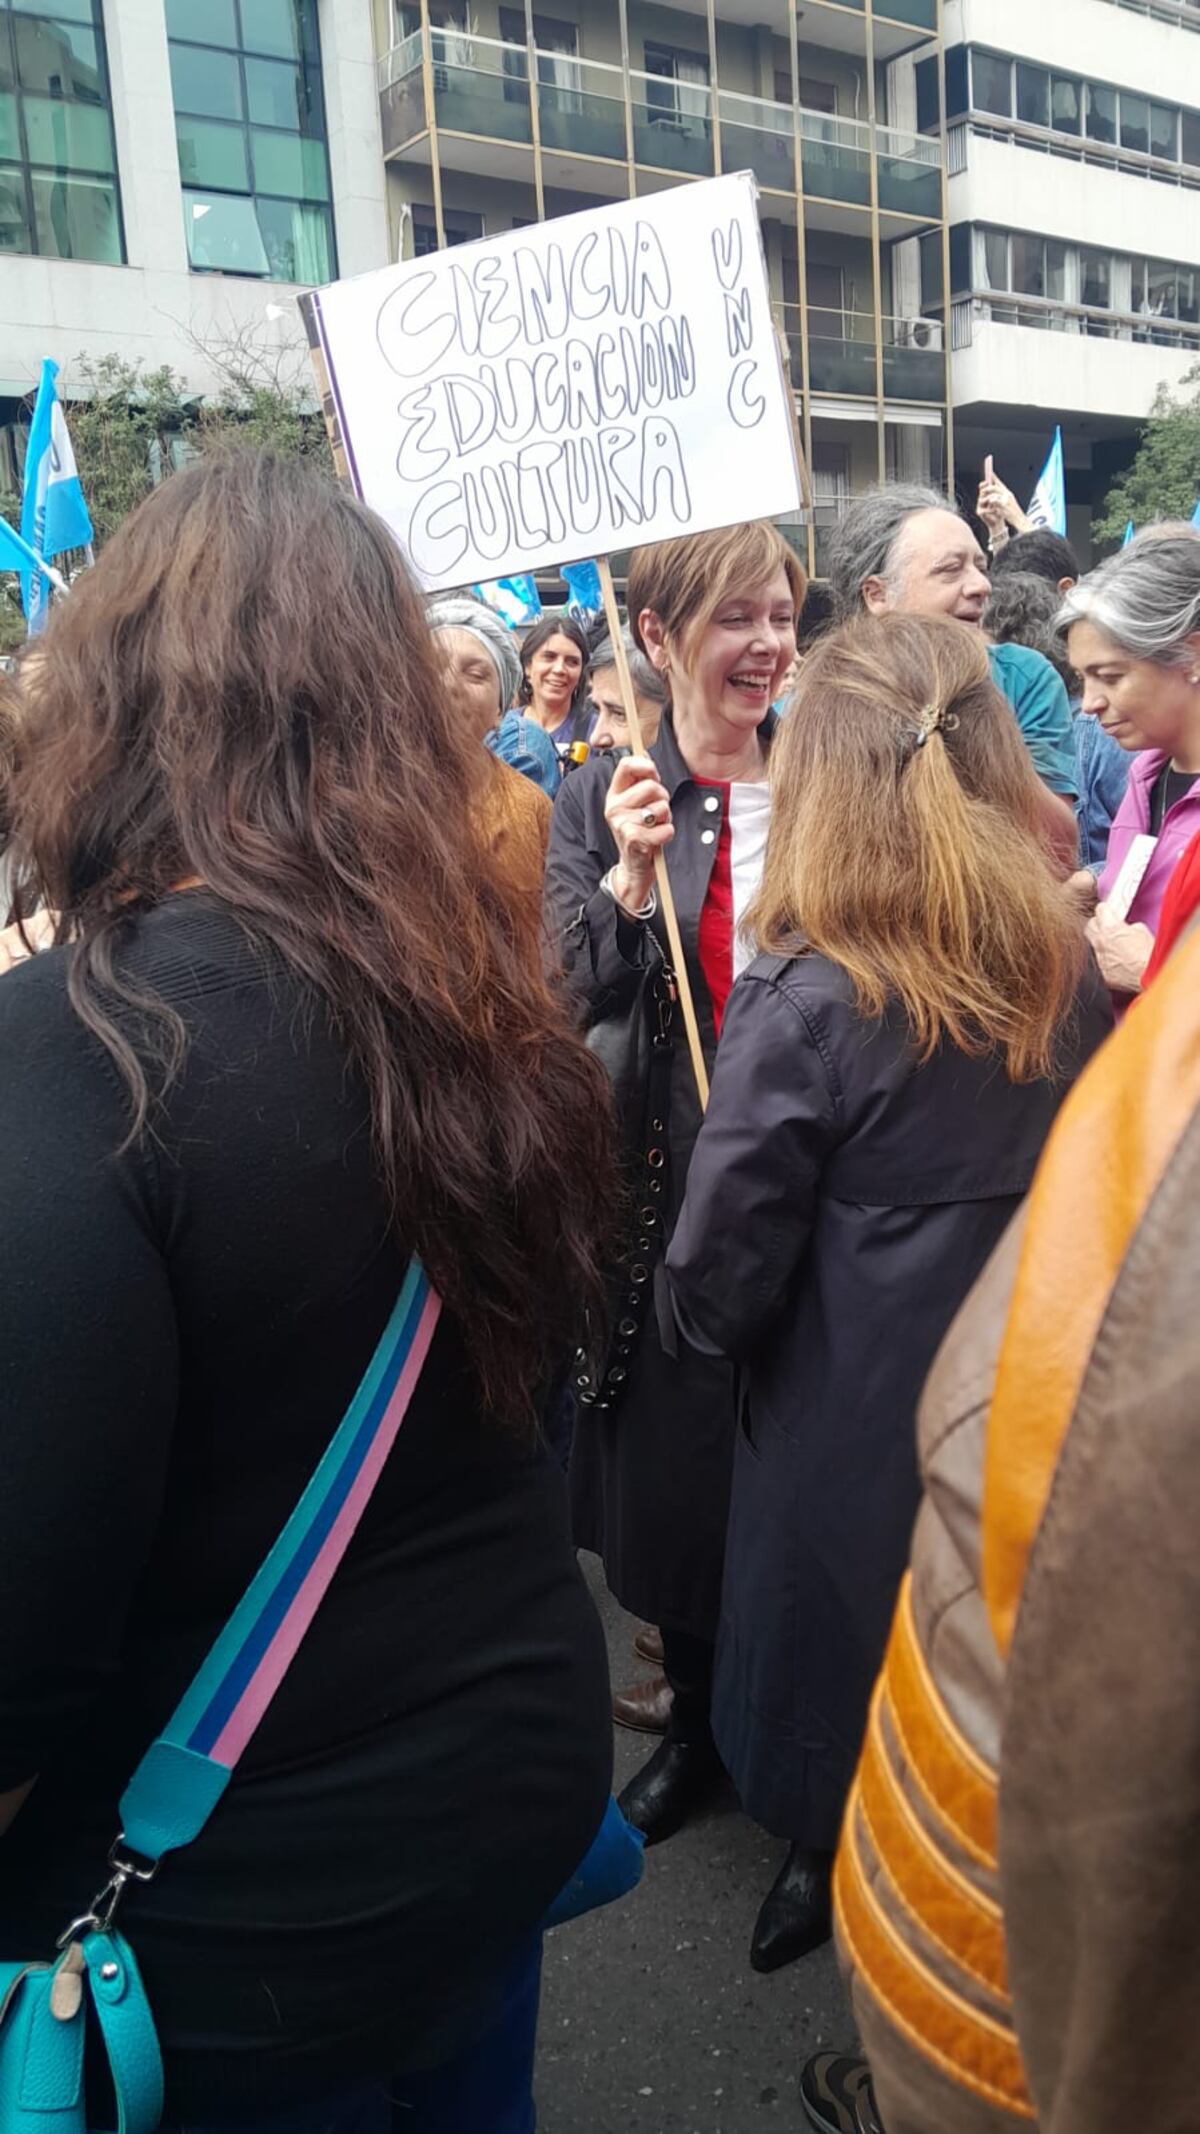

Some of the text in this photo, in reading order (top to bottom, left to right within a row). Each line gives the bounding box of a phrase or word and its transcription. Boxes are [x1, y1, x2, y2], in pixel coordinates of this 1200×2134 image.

[376, 220, 671, 377] CIENCIA
[712, 218, 766, 429] UNC
[396, 315, 696, 482] EDUCACION
[408, 416, 692, 577] CULTURA
